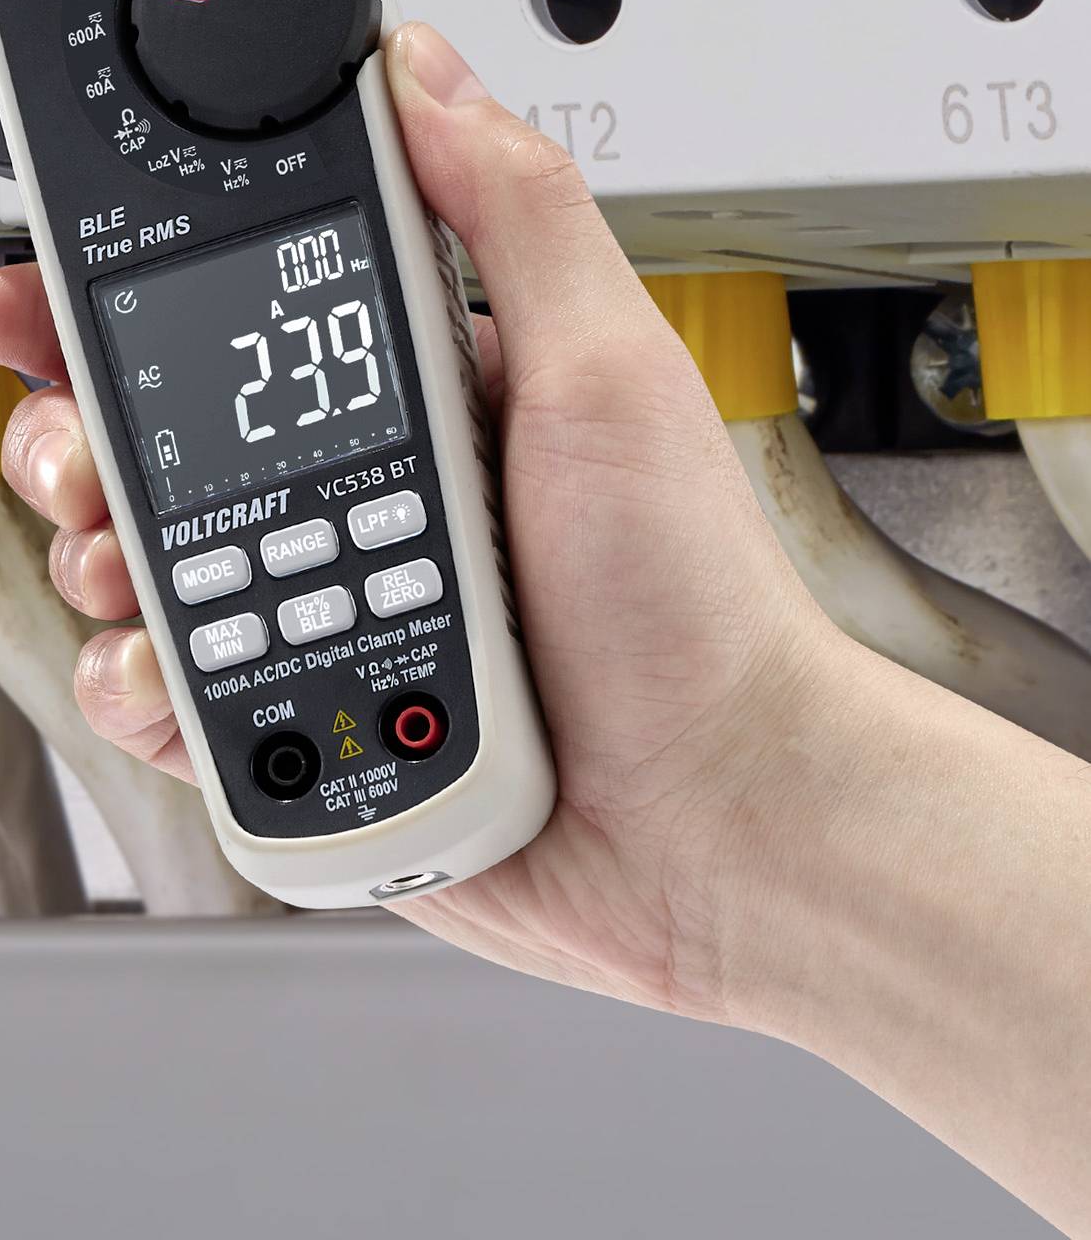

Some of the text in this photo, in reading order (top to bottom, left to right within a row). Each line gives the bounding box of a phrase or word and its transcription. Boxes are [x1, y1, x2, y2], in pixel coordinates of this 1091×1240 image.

[68, 23, 106, 47] 600A
[86, 78, 116, 99] 60A
[119, 135, 146, 155] CAP
[178, 158, 206, 177] Hz%
[220, 159, 232, 176] V
[275, 152, 307, 176] OFF
[223, 174, 250, 192] Hz%
[79, 206, 126, 239] BLE
[82, 215, 191, 265] True RMS
[270, 300, 285, 320] A
[138, 365, 161, 386] AC
[230, 299, 382, 444] 23.9
[317, 455, 418, 501] VC538 BT
[161, 488, 291, 551] VOLTCRAFT
[357, 509, 389, 534] LPF
[265, 530, 329, 564] RANGE
[181, 559, 235, 590] MODE
[382, 569, 417, 592] REL
[294, 595, 331, 619] Hz%
[380, 582, 427, 610] ZERO
[205, 619, 244, 646] MAX
[299, 610, 334, 635] BLE
[203, 613, 453, 702] 1000A AC/DC Digital Clamp Meter
[212, 637, 245, 661] MIN
[410, 643, 439, 662] CAP
[371, 661, 438, 693] Hz% TEMP
[252, 700, 296, 728] COM
[320, 761, 397, 797] CAT II 1000V
[325, 778, 398, 812] CAT III 600V
